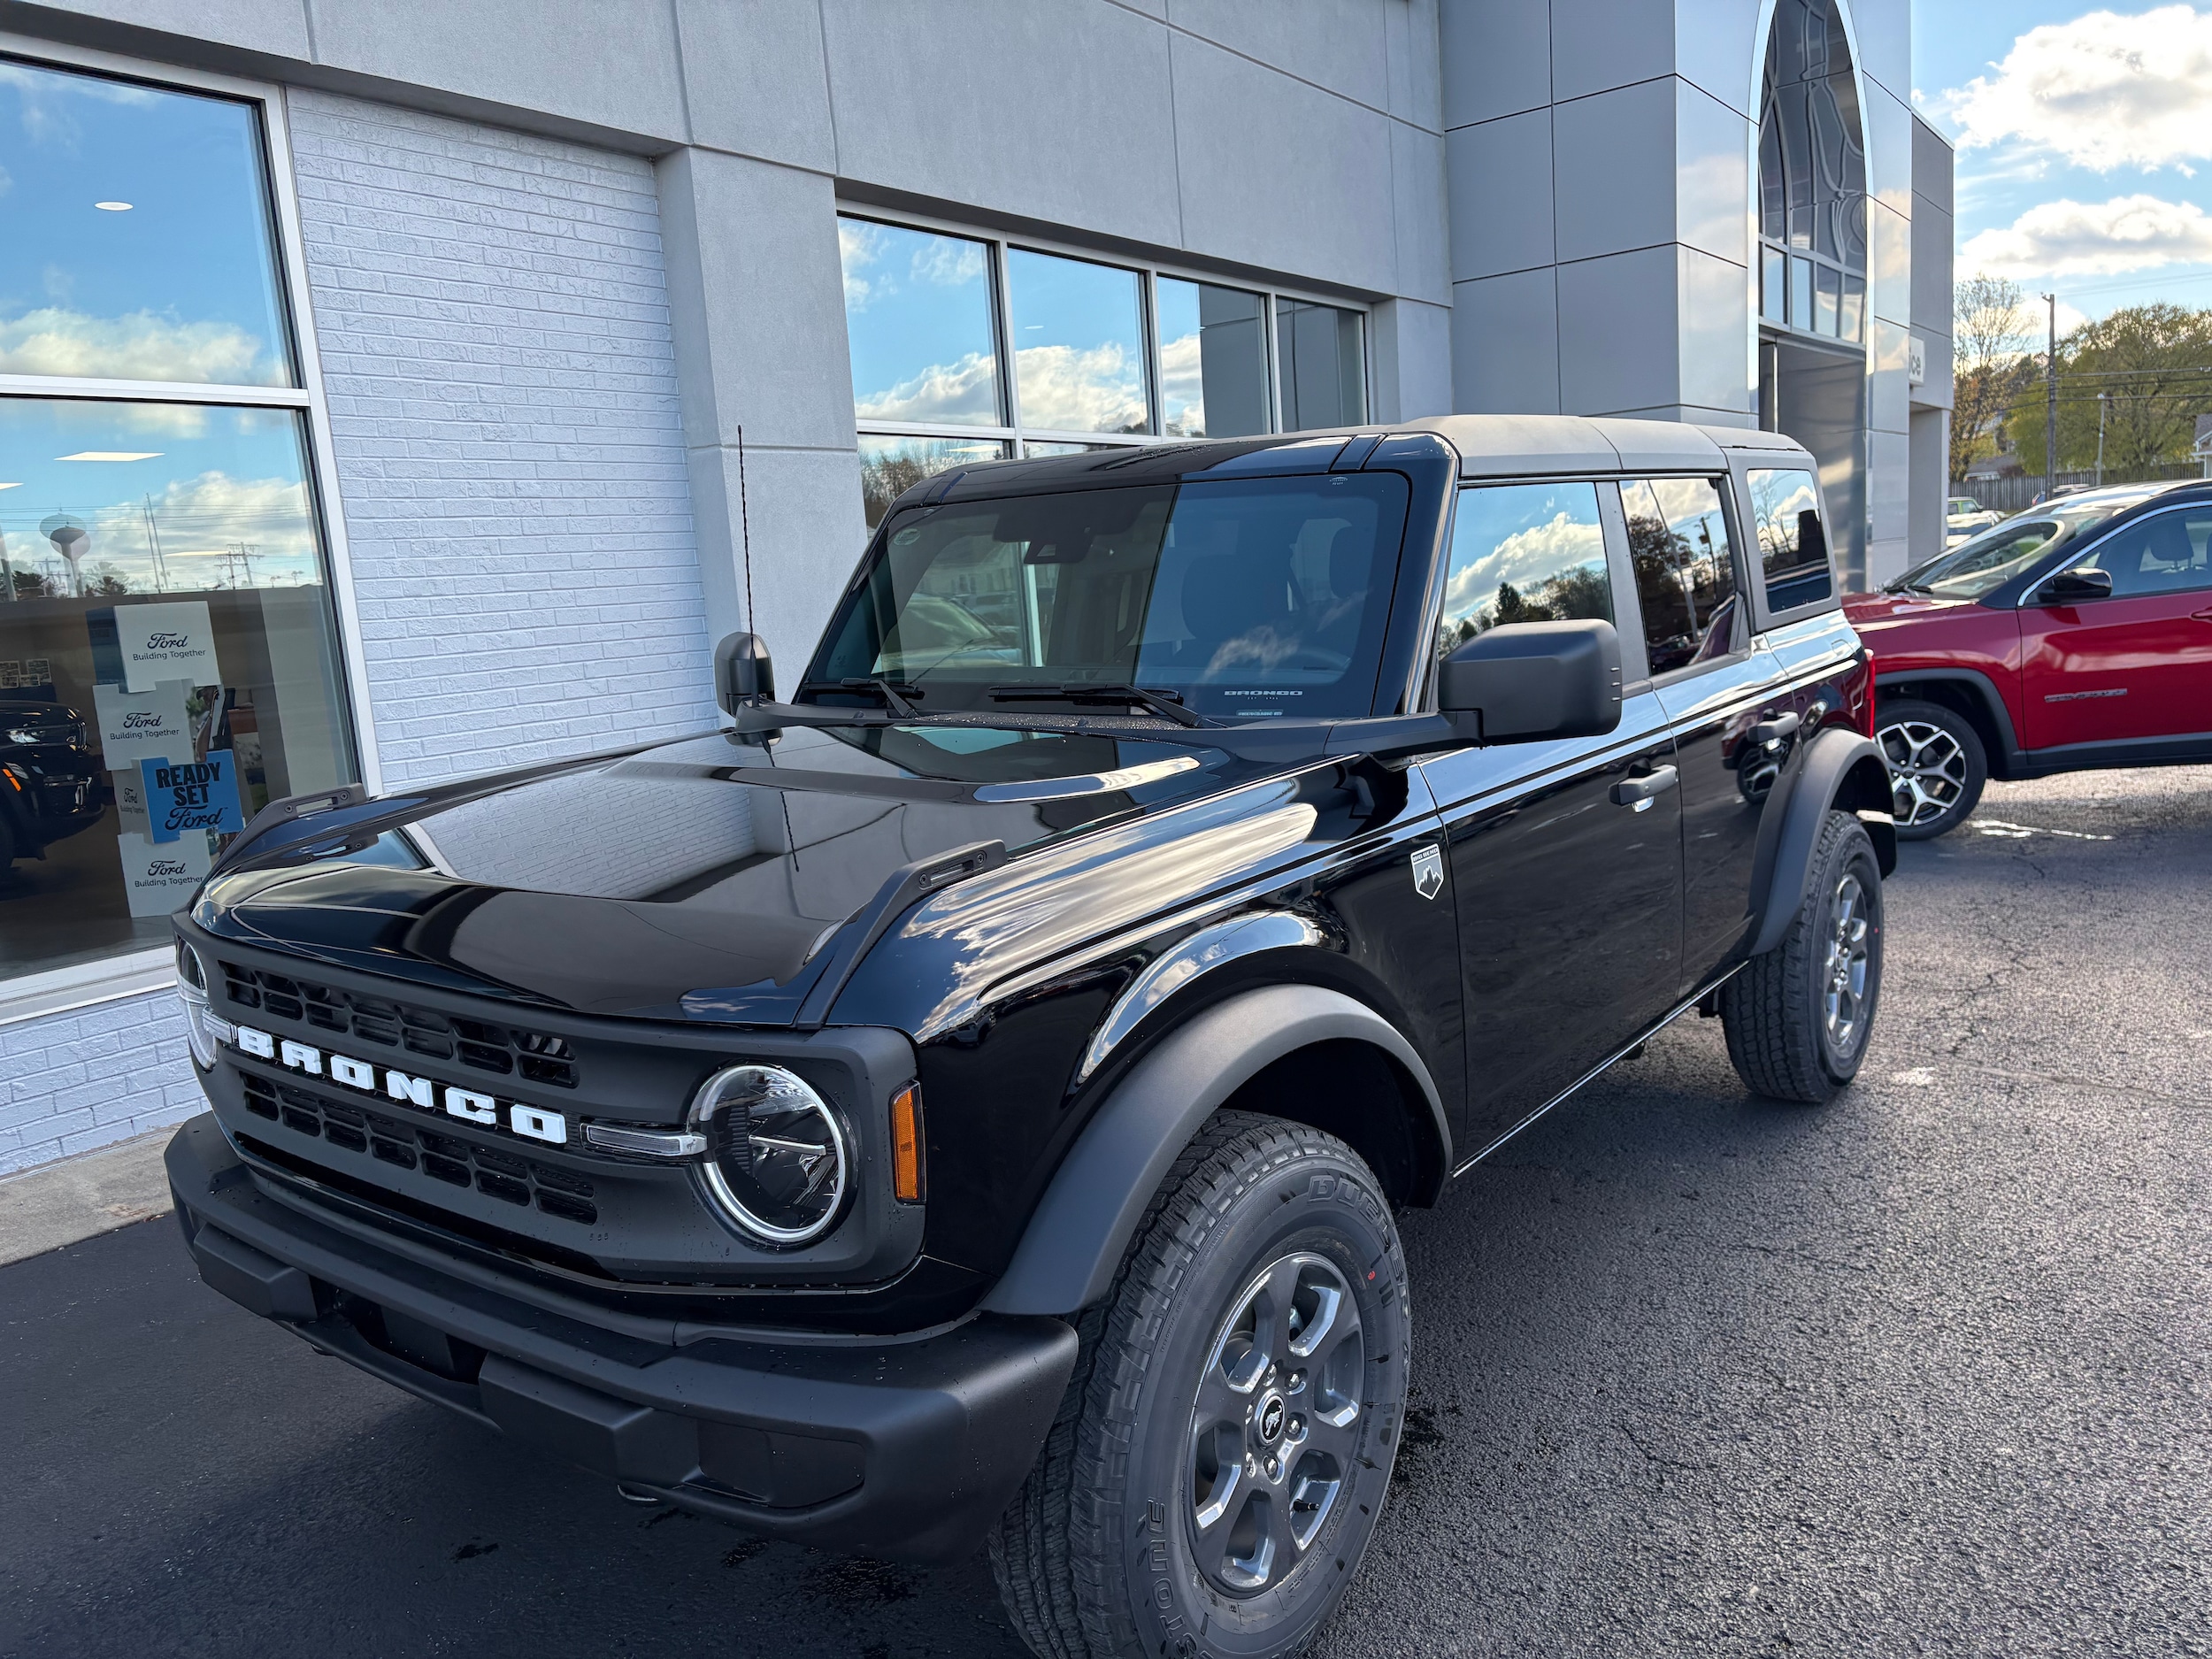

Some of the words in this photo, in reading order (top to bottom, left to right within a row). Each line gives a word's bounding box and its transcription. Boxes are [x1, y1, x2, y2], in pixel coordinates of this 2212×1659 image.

[147, 633, 188, 649] Ford
[133, 652, 167, 661] Building
[169, 649, 206, 659] Together
[123, 712, 162, 728] Ford
[110, 731, 142, 741] Building
[145, 728, 180, 739] Together
[156, 762, 220, 788] READY
[123, 787, 138, 803] Ford
[173, 783, 209, 806] SET
[165, 804, 224, 830] Ford
[148, 860, 187, 876] Ford
[134, 879, 167, 887] Building
[169, 876, 204, 886] Together
[237, 1025, 567, 1144] BRONCO
